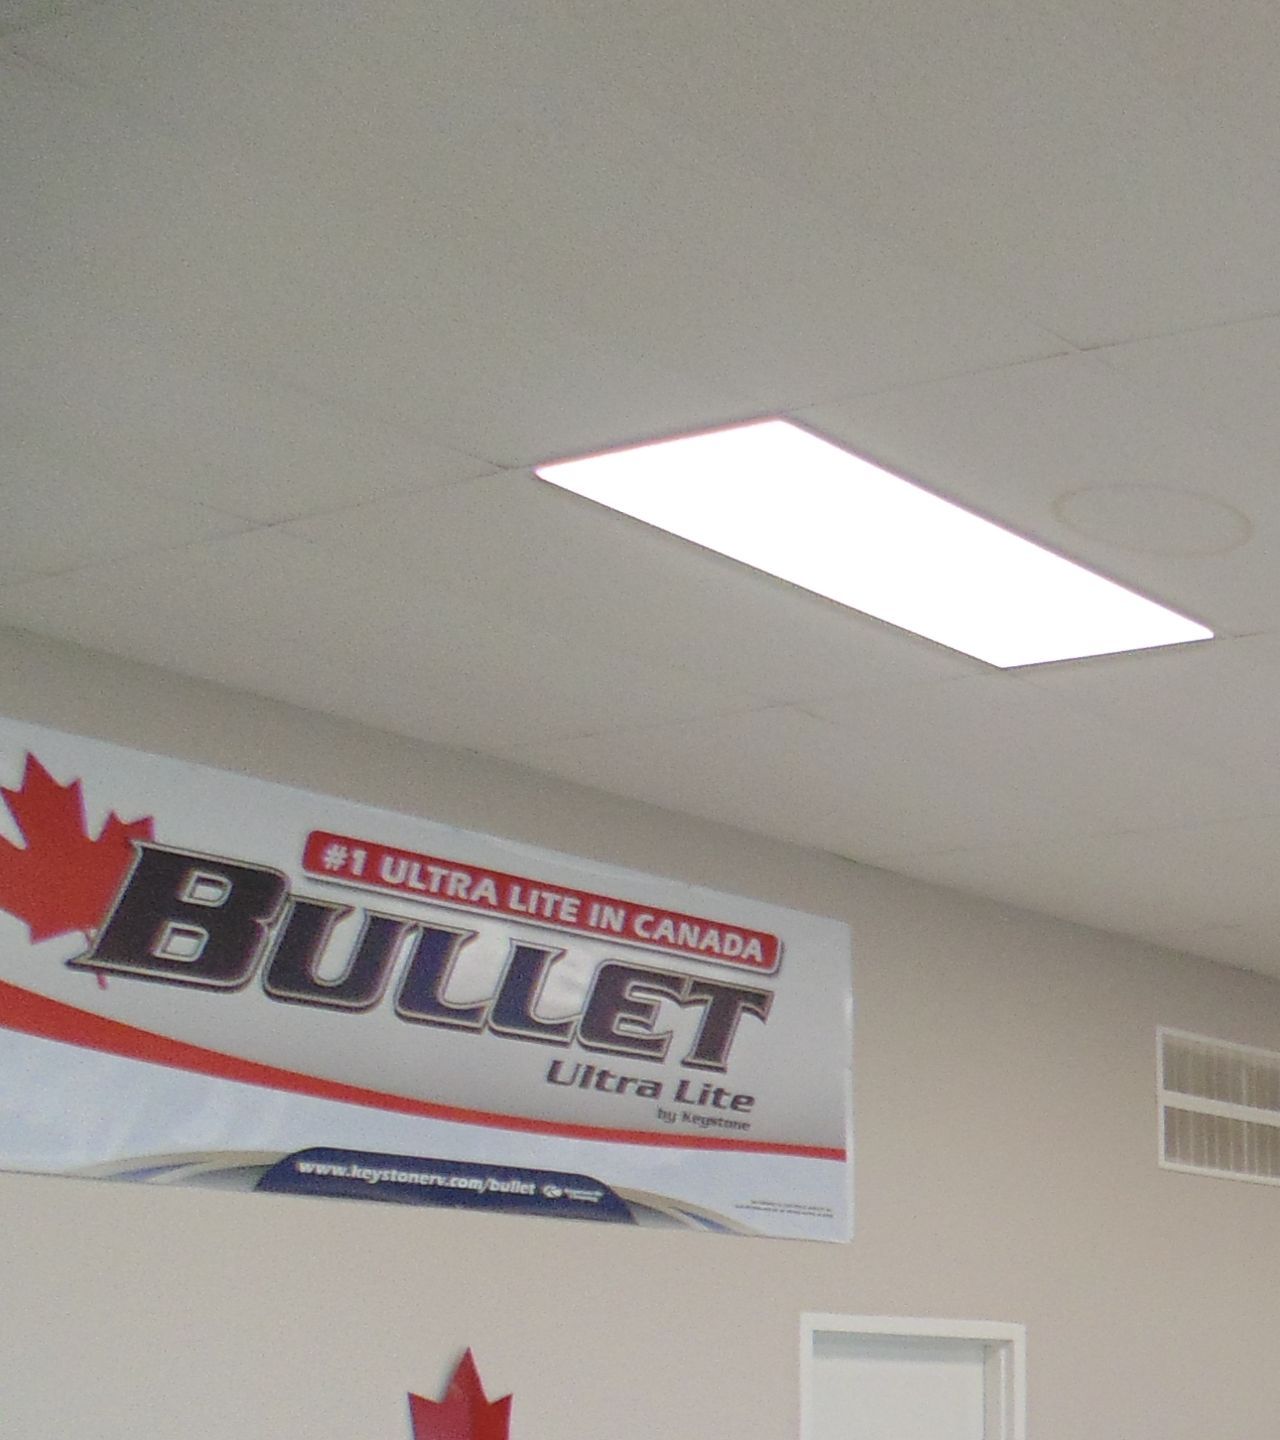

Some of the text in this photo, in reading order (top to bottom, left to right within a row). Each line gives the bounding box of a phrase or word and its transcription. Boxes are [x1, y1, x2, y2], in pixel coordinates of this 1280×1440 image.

[323, 843, 764, 963] #1 ULTRA LITE IN CANADA
[65, 839, 776, 1075] BULLET
[546, 1059, 756, 1113] Ultra Lite
[657, 1108, 751, 1132] by Keystone
[297, 1161, 537, 1195] www.keystonerv.com/bullet
